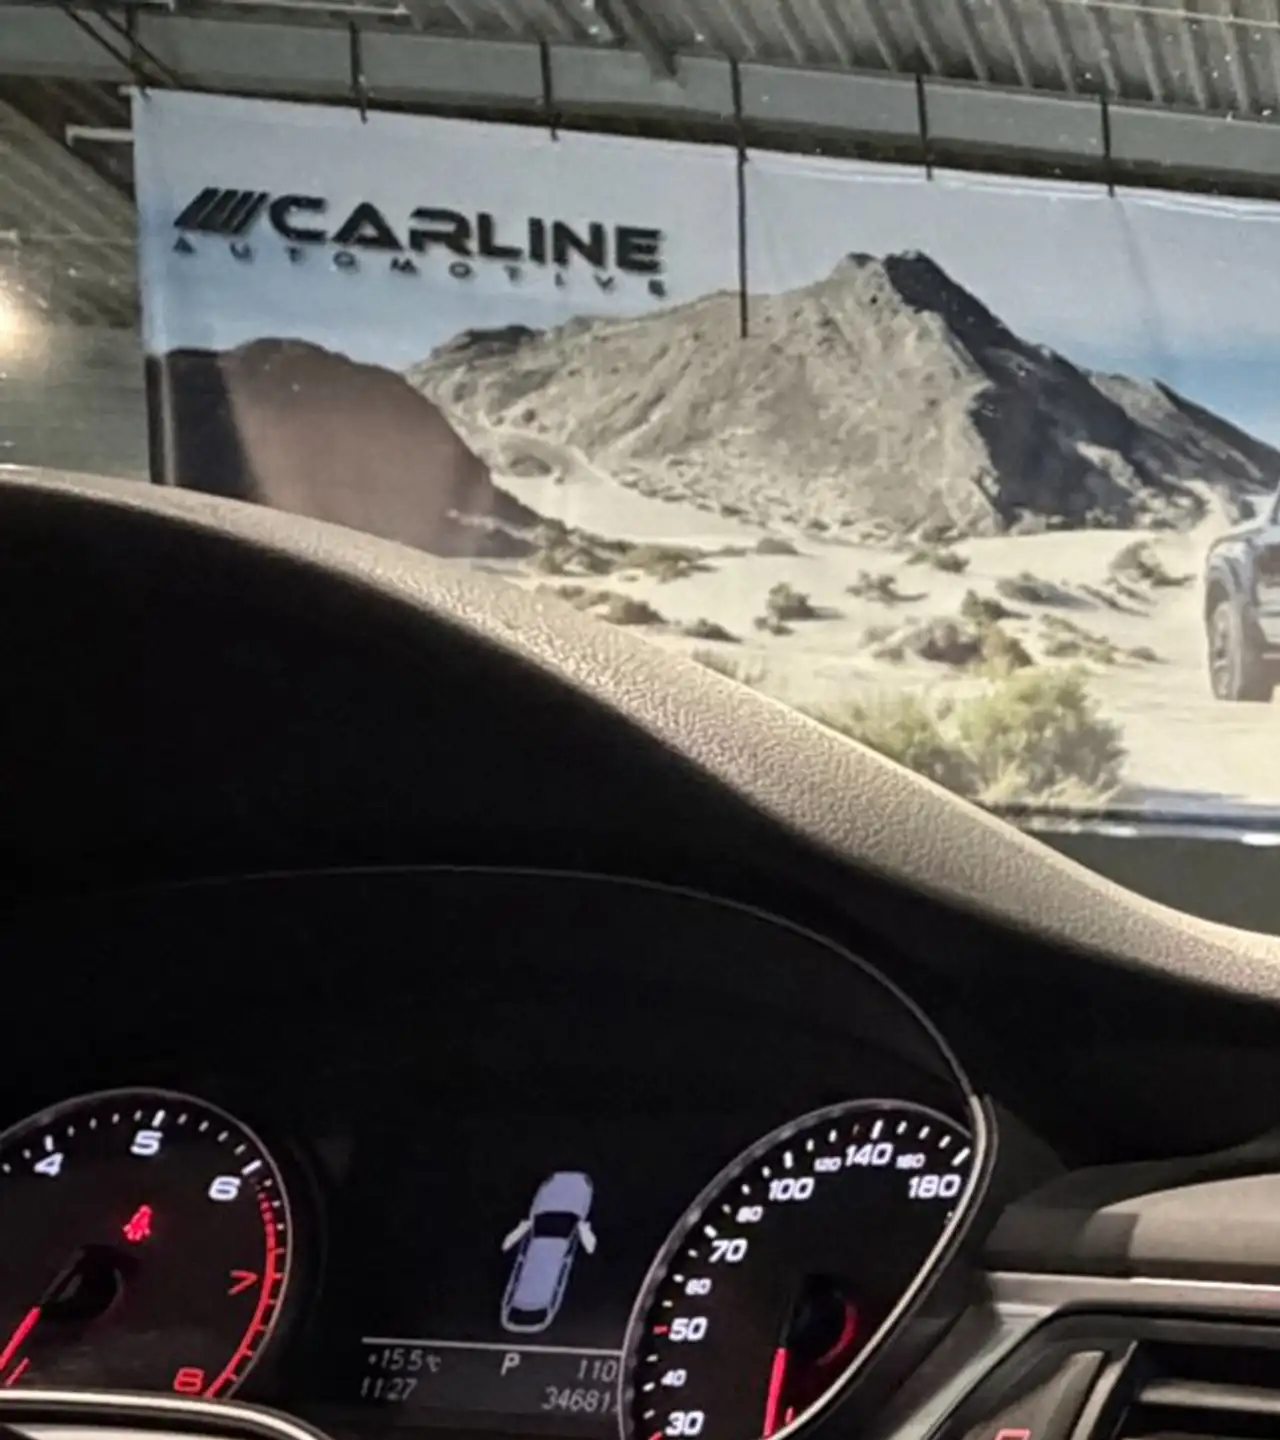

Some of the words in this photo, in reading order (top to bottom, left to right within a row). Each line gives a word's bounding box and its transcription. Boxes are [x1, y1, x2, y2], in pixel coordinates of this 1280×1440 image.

[267, 195, 663, 273] CARLINE
[173, 235, 667, 298] AUTOMOTIVE
[130, 1130, 163, 1156] 5
[844, 1142, 894, 1167] 140
[34, 1153, 64, 1176] 4
[208, 1176, 242, 1201] 6
[768, 1177, 815, 1201] 100
[907, 1174, 961, 1199] 180
[707, 1238, 749, 1263] 70
[228, 1269, 258, 1295] 7
[667, 1316, 708, 1341] 50
[501, 1352, 521, 1376] P
[173, 1367, 205, 1392] 8
[661, 1369, 688, 1387] 40
[665, 1410, 706, 1437] 30
